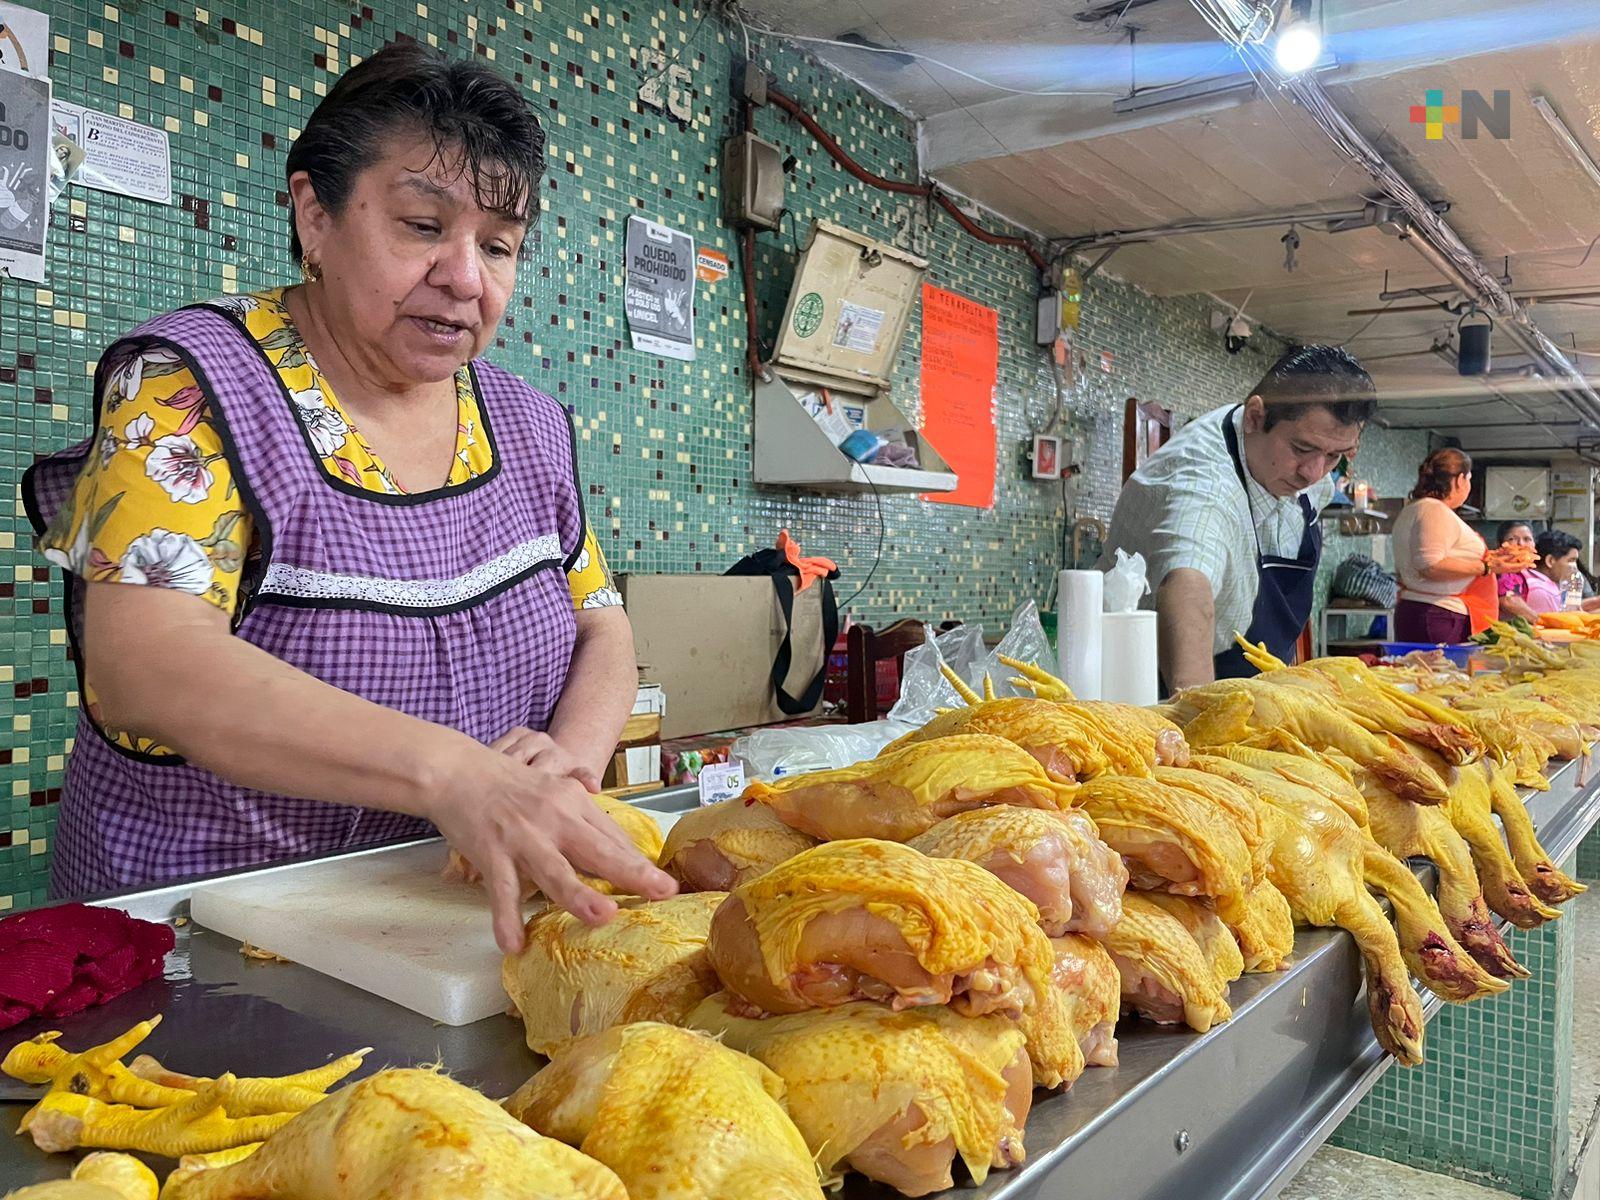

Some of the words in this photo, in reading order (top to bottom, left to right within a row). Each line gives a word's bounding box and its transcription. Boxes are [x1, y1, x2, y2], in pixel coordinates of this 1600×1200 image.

[643, 245, 677, 266] QUEDA
[699, 257, 726, 271] CENSADO
[634, 256, 686, 282] PROHIBIDO
